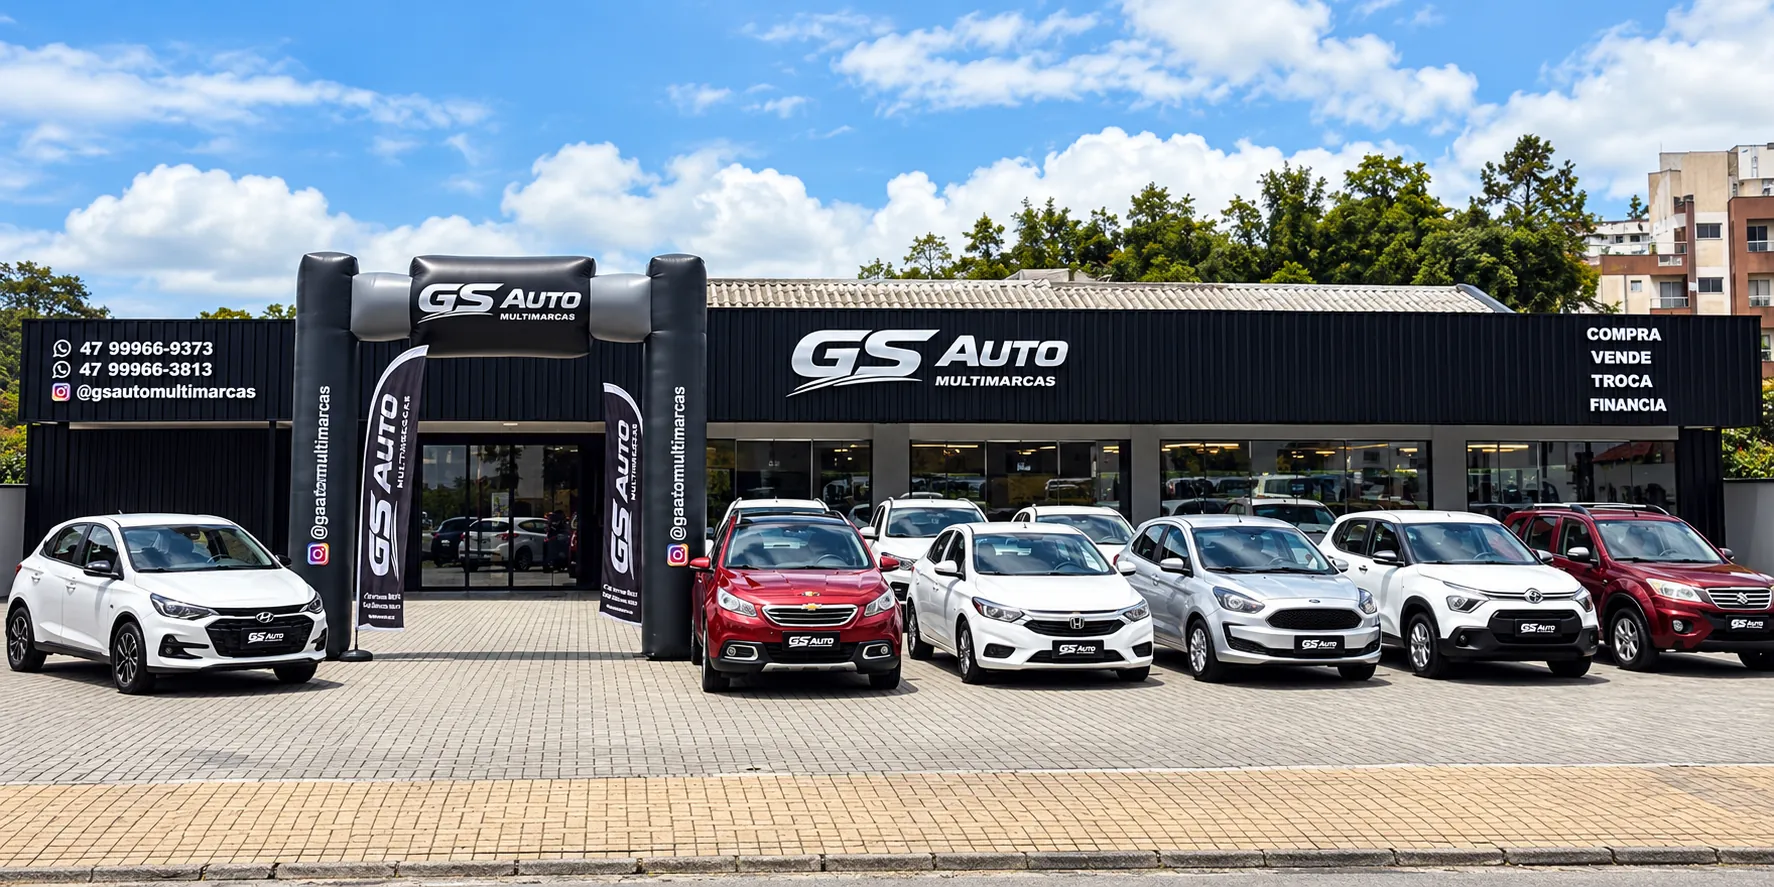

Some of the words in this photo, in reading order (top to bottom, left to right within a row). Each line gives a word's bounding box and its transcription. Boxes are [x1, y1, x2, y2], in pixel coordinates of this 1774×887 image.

[418, 283, 504, 315] GS
[499, 288, 582, 309] AUTO
[500, 313, 575, 321] MULTIMARCAS
[1586, 327, 1662, 341] COMPRA
[79, 341, 103, 356] 47
[108, 341, 214, 356] 99966-9373
[791, 329, 940, 379] GS
[934, 335, 1069, 367] AUTO
[1590, 350, 1652, 364] VENDE
[79, 362, 103, 377] 47
[108, 362, 213, 377] 99966-3813
[935, 375, 1056, 387] MULTIMARCAS
[1590, 373, 1654, 388] TROCA
[76, 383, 257, 402] @gsautomultimarcas
[1589, 397, 1668, 412] FINANCIA
[373, 393, 399, 494] AUTO
[615, 419, 630, 504] AUTO
[369, 489, 393, 577] GS
[610, 497, 630, 575] GS
[1521, 623, 1538, 632] GS
[1731, 619, 1747, 628] GS
[248, 632, 267, 642] GS
[789, 635, 812, 646] GS
[1302, 639, 1320, 649] GS
[1059, 644, 1078, 653] GS
